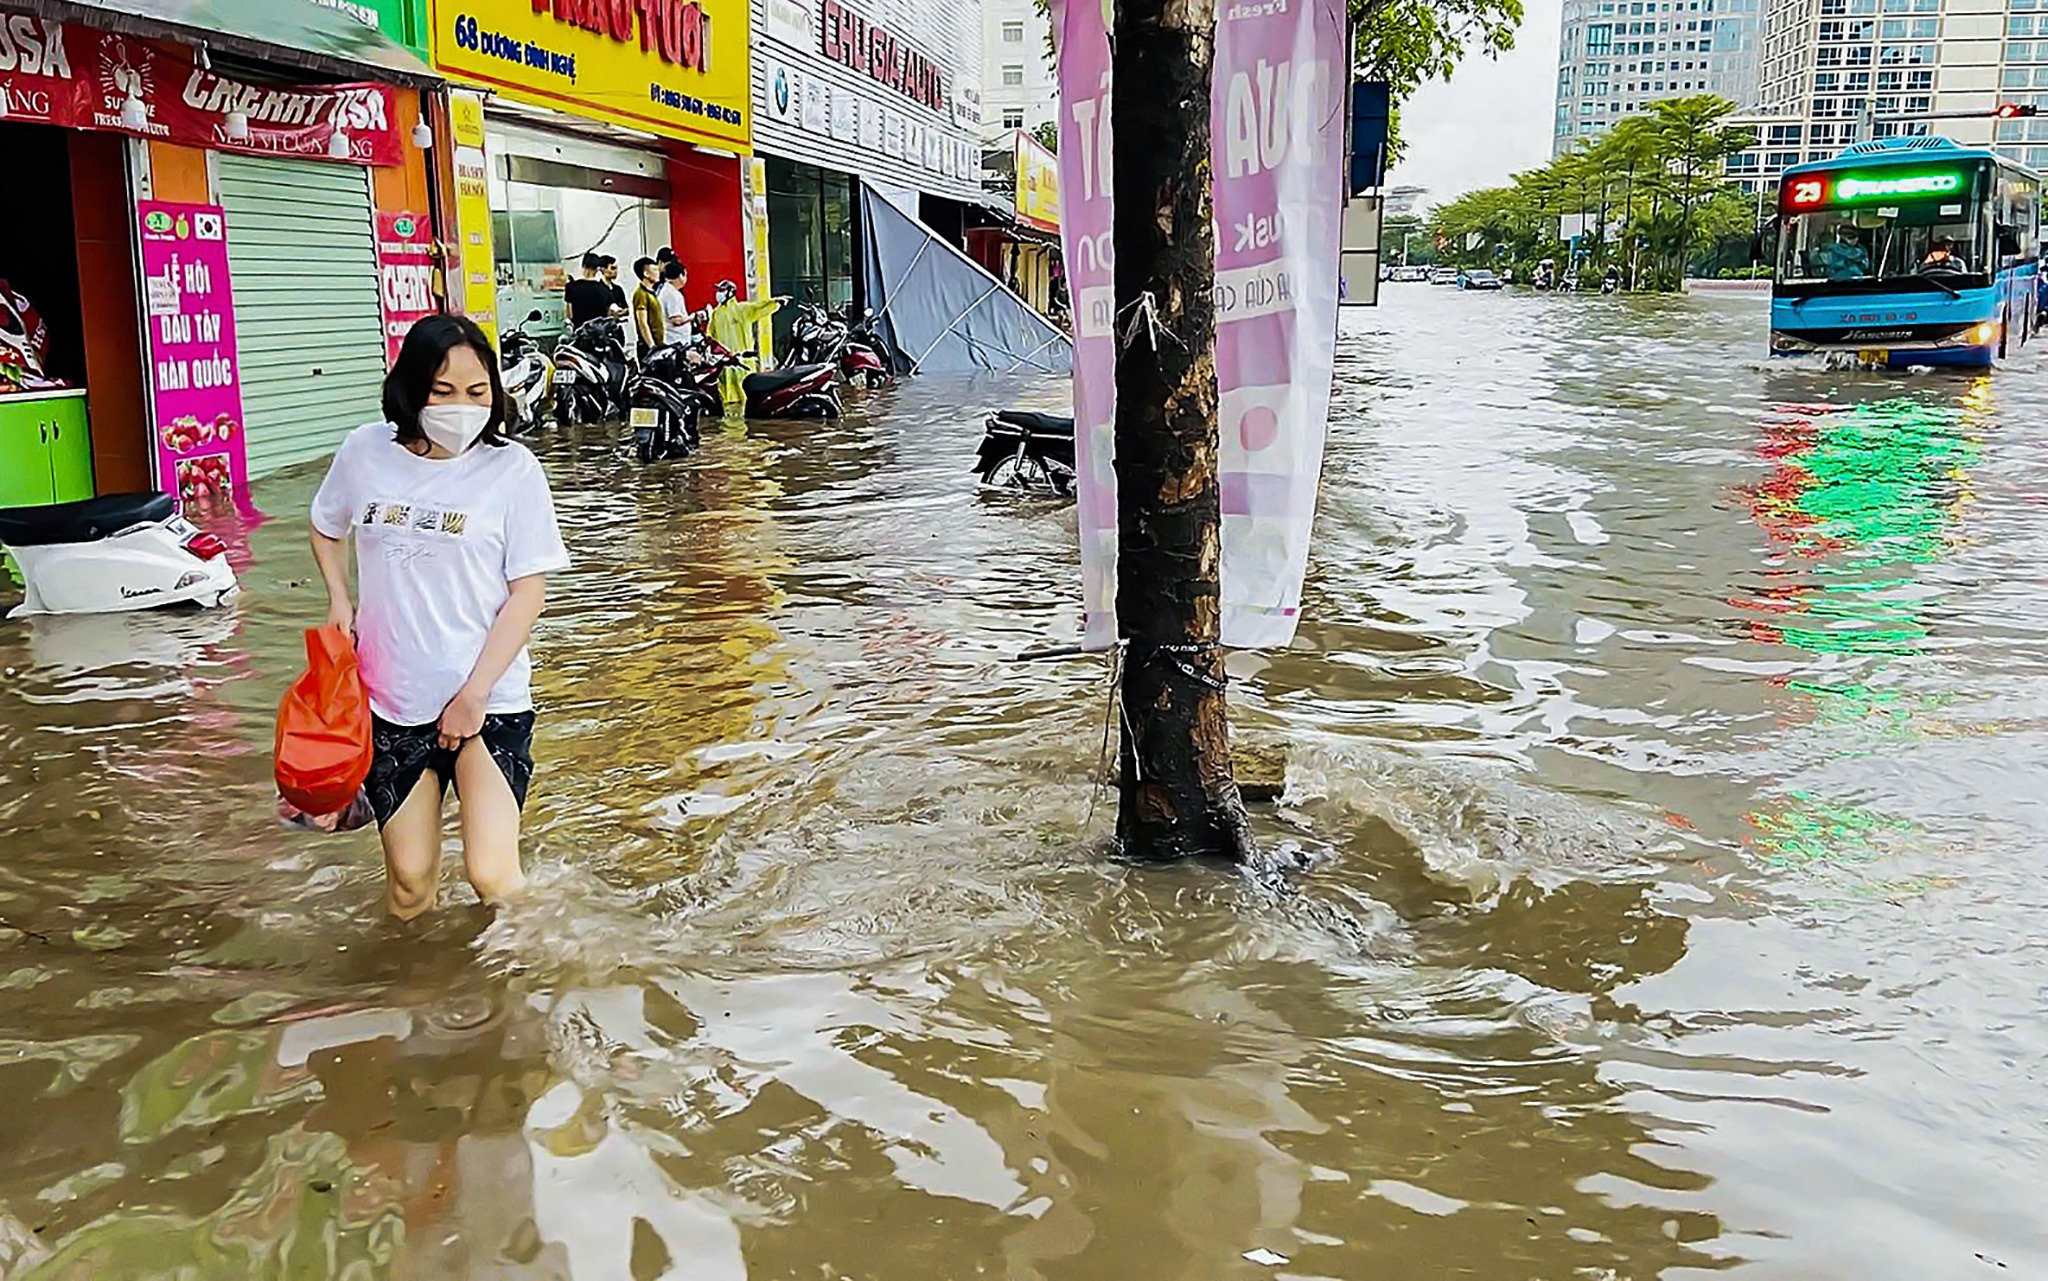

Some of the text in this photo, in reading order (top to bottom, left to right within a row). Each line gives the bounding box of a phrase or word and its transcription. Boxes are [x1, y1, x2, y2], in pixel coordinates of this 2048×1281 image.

[455, 14, 478, 51] 68
[822, 0, 867, 72] CHU
[869, 26, 901, 92] GIA
[901, 47, 943, 112] AUTO
[183, 68, 389, 131] CHERRY USA
[184, 259, 211, 300] HỘI
[194, 308, 221, 343] TÂY
[158, 348, 233, 391] HÀN QUỐC
